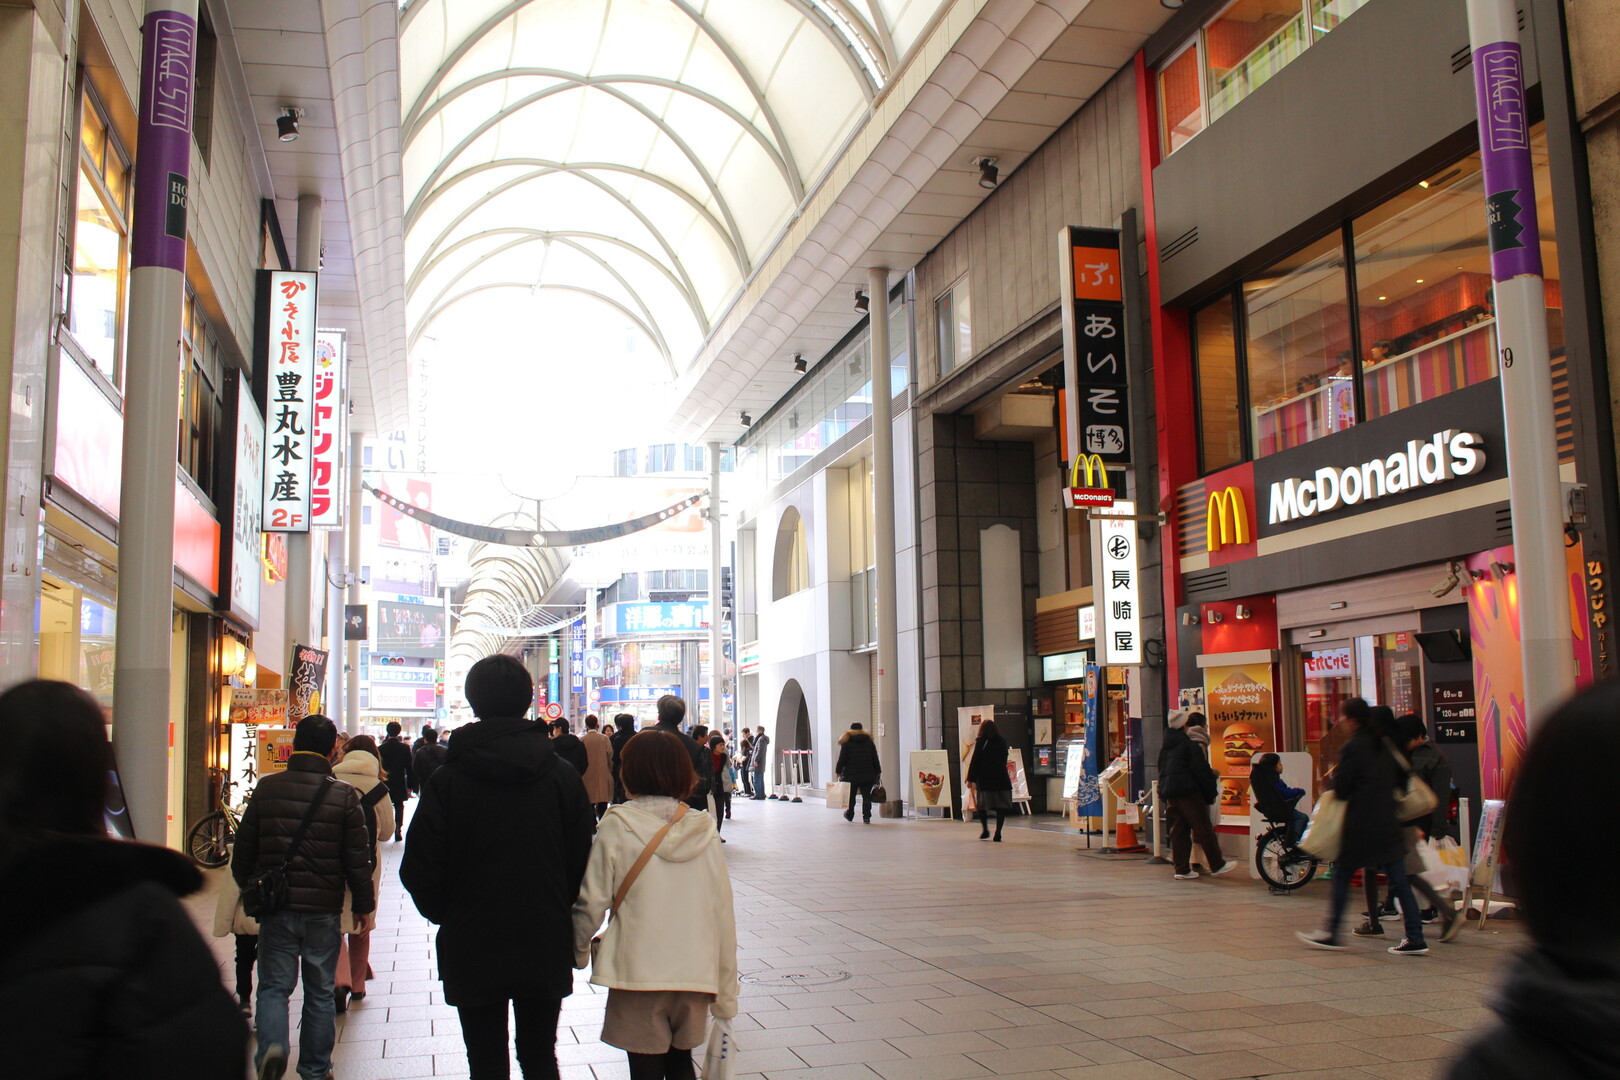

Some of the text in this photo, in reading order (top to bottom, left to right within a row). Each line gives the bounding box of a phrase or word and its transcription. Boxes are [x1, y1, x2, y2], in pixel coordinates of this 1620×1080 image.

[157, 26, 191, 126] STAGE 577
[1489, 54, 1525, 145] STAGE 577
[279, 280, 306, 364] かき小屋
[1504, 347, 1513, 368] 9
[270, 370, 306, 502] 豊丸水産
[1087, 427, 1123, 452] 博多
[1074, 493, 1112, 502] McDonald's
[1269, 429, 1481, 525] McDonald's
[271, 508, 303, 527] 2F
[1111, 570, 1133, 651] 長崎屋
[1587, 561, 1608, 628] ひつじや
[1443, 690, 1451, 698] 69
